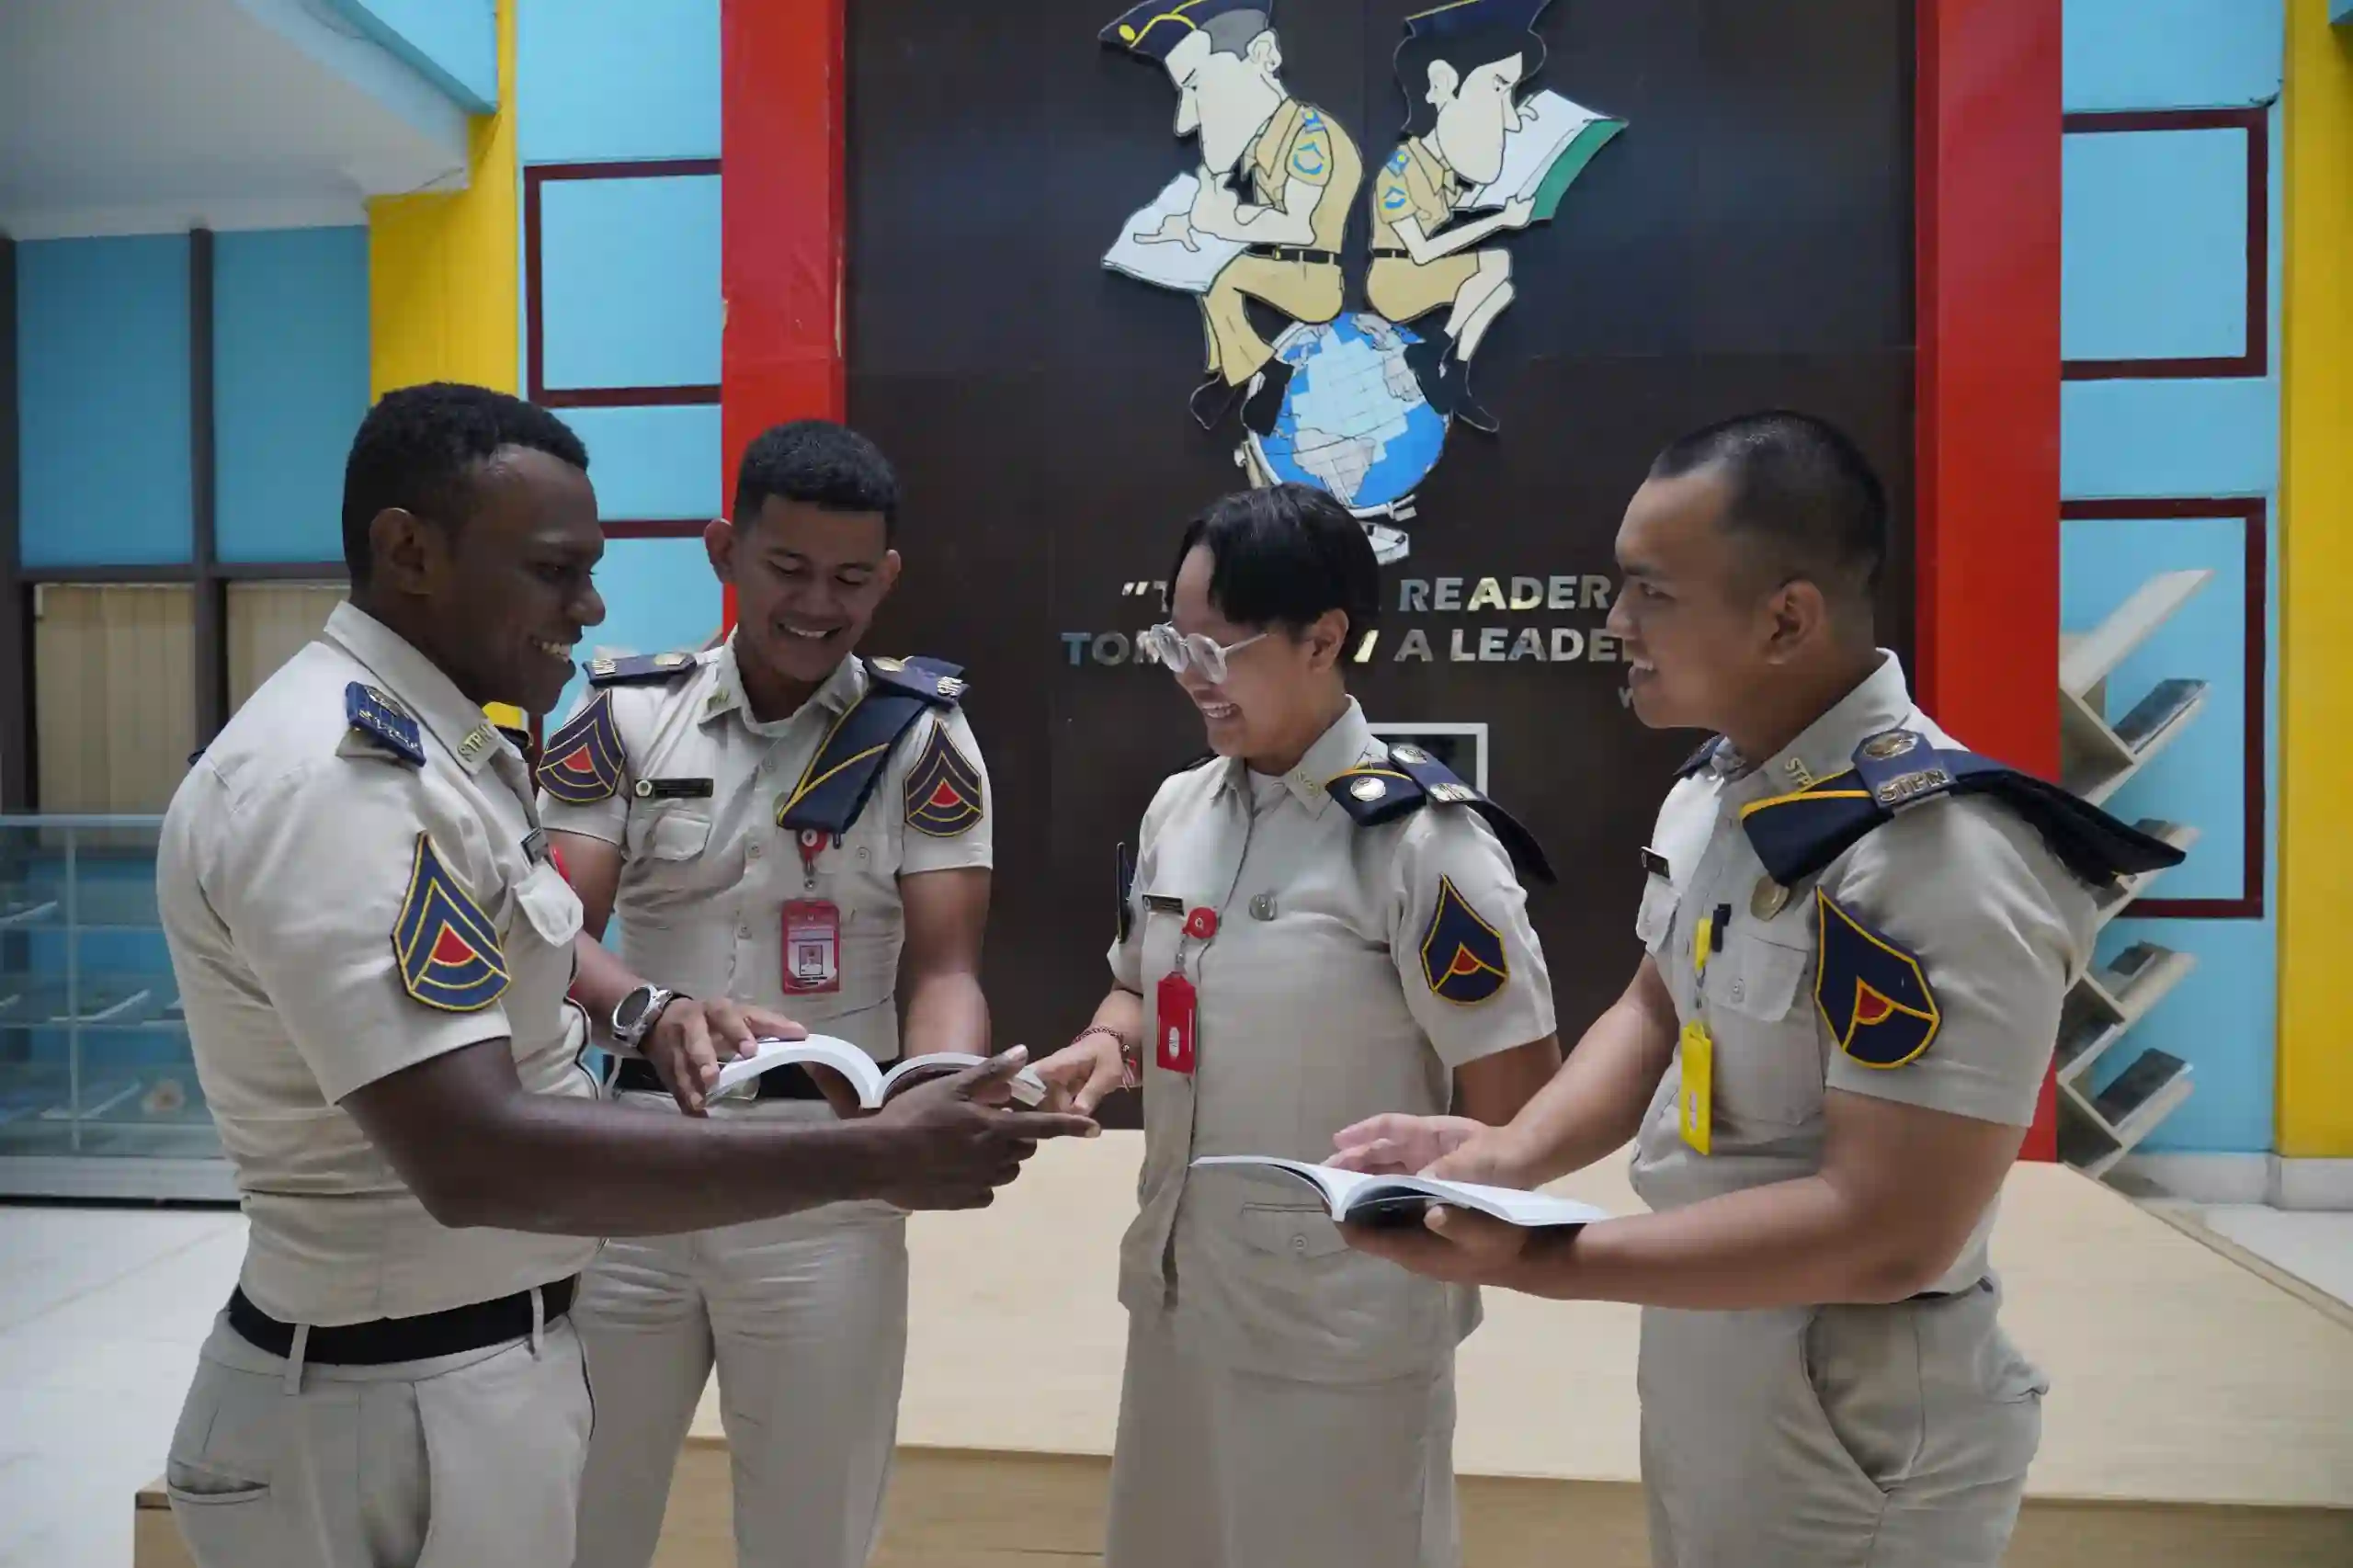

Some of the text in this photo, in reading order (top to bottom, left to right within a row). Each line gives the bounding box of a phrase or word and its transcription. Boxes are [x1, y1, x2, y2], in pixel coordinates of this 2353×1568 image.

[1398, 574, 1611, 611] READER
[1393, 629, 1434, 662] A
[1878, 768, 1949, 802] STPN
